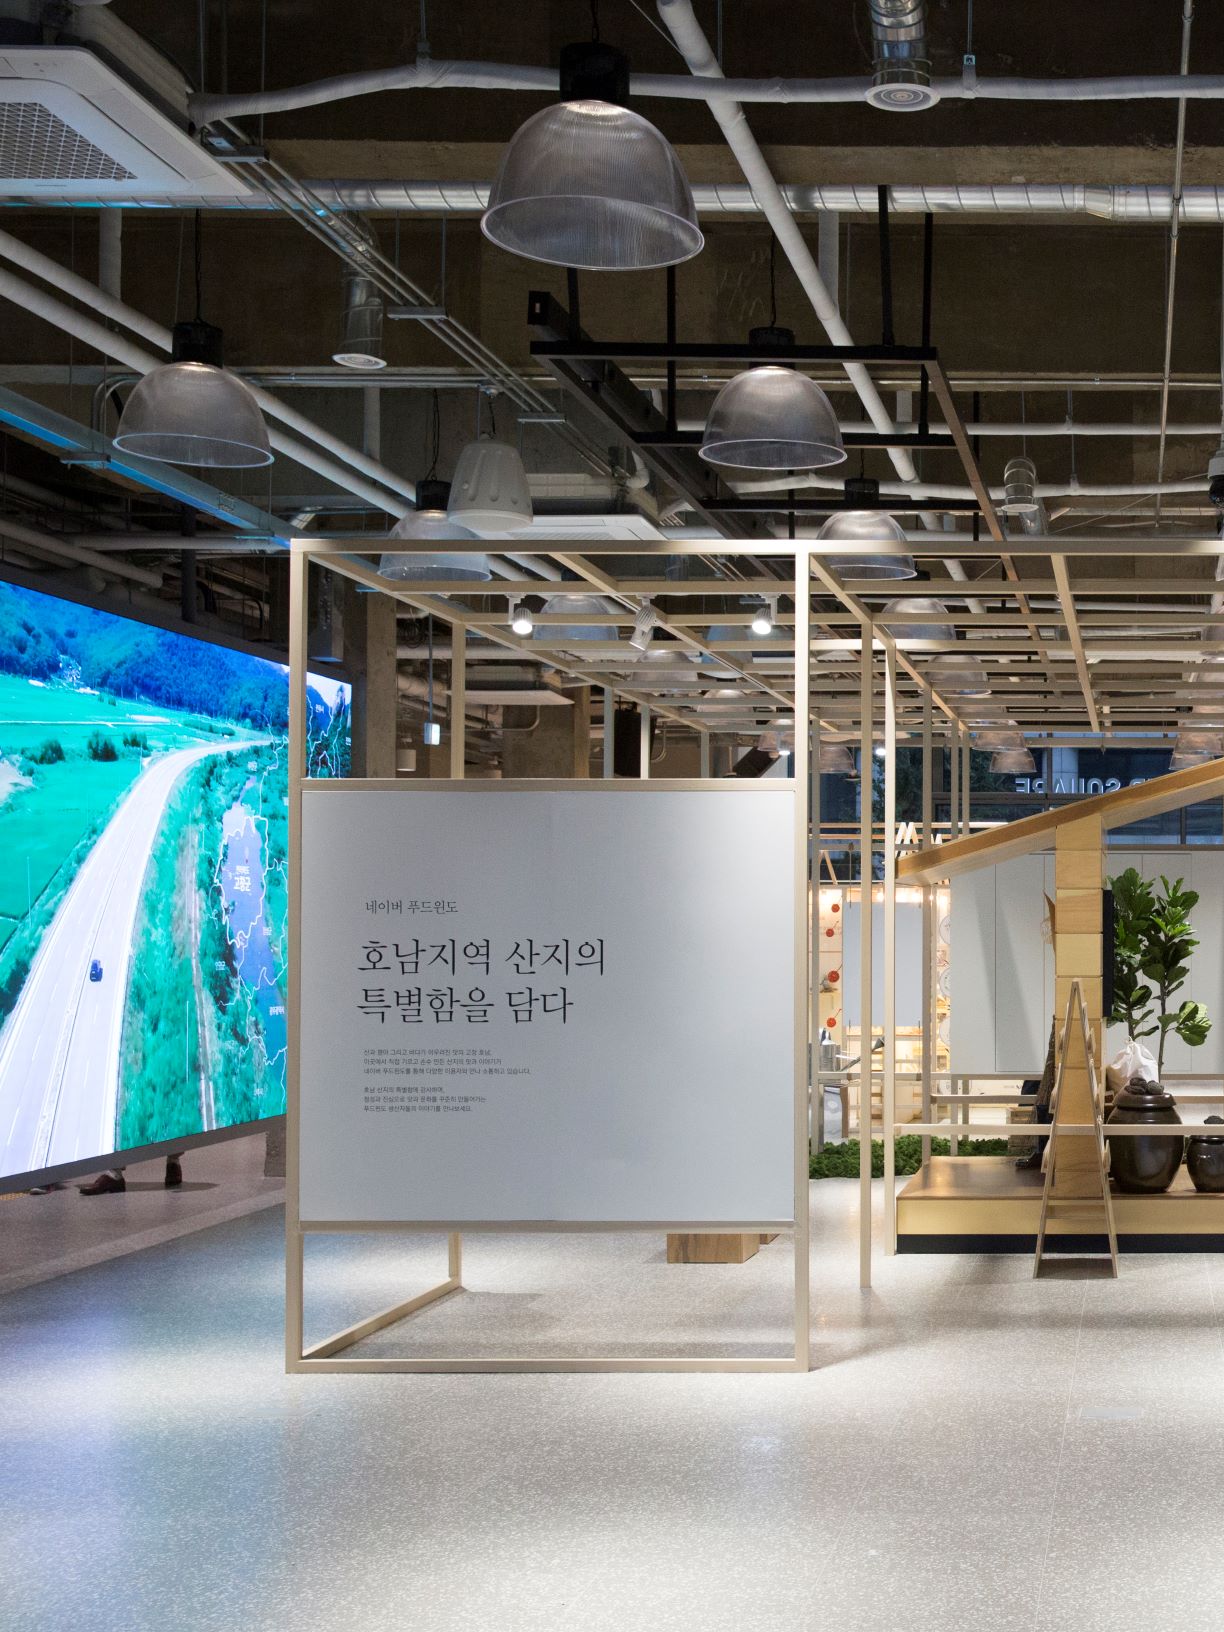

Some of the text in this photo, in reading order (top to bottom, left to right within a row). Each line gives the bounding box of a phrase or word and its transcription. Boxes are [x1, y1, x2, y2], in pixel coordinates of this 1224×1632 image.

[365, 900, 459, 915] 네이버 푸드윈도
[357, 938, 604, 976] 호남지역 산지의
[356, 986, 575, 1025] 특별함을 담다
